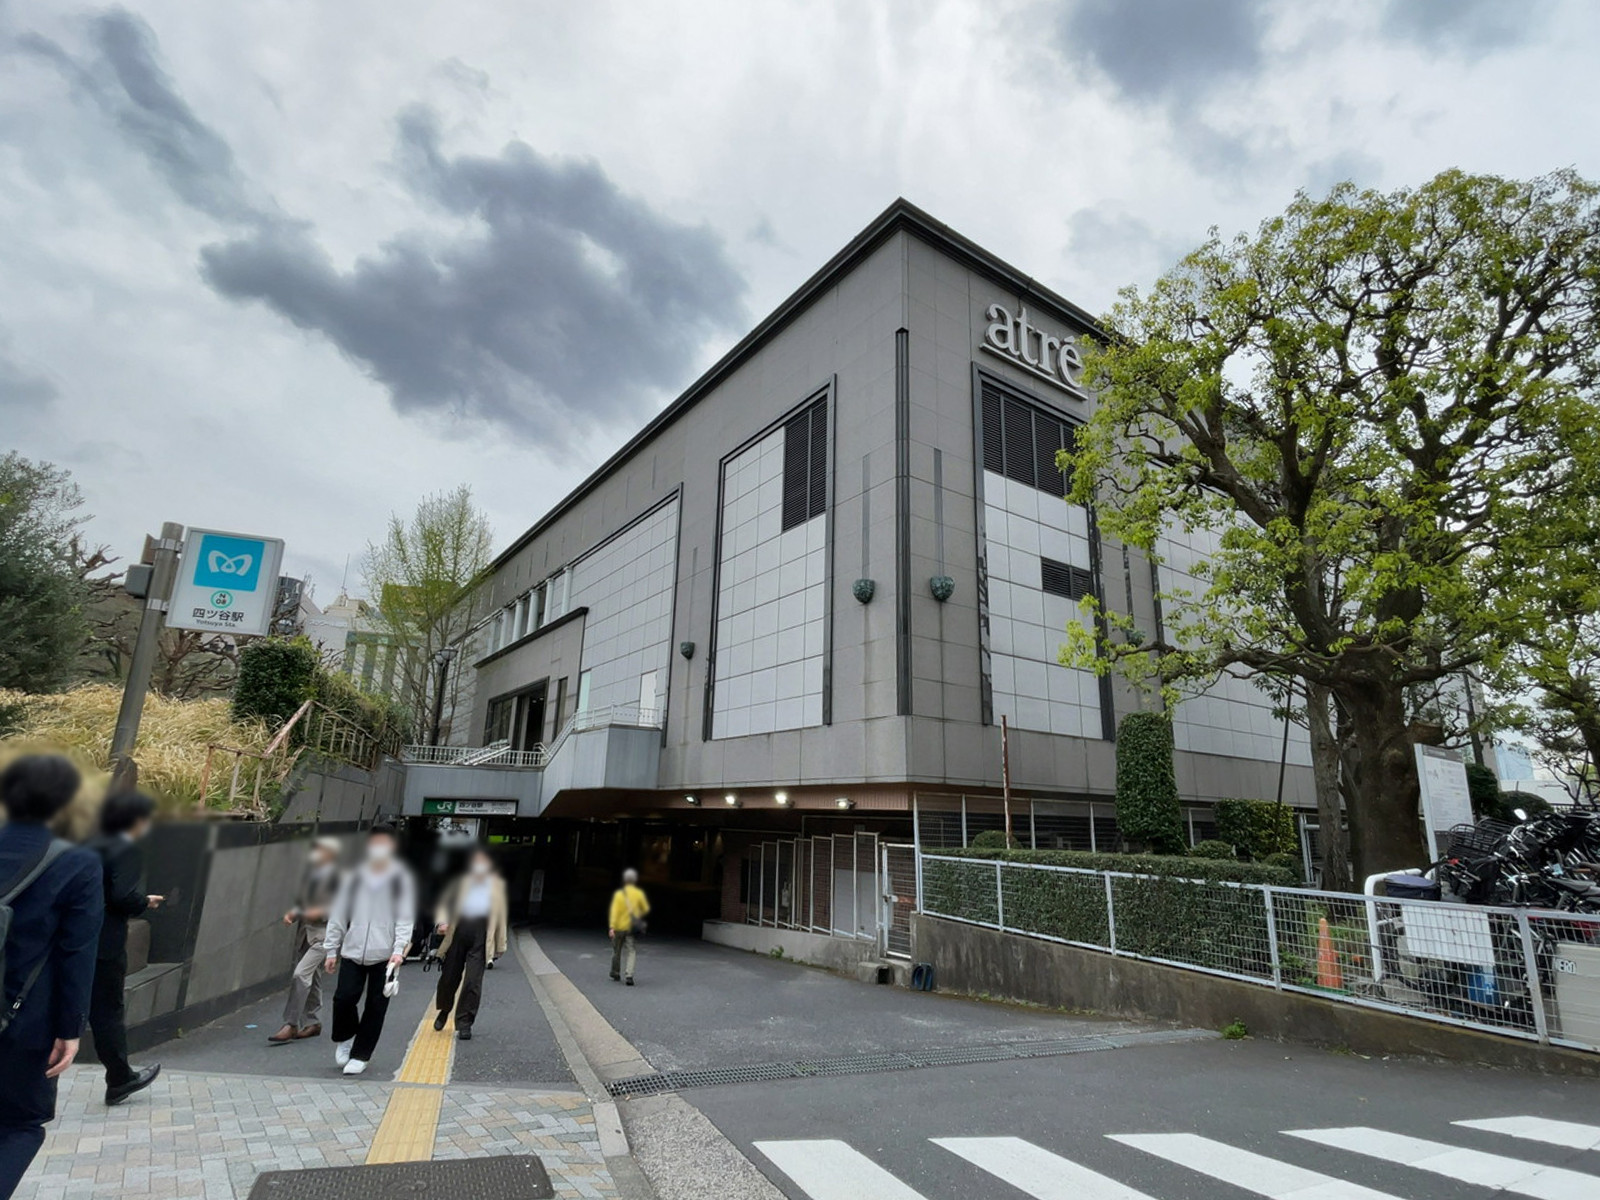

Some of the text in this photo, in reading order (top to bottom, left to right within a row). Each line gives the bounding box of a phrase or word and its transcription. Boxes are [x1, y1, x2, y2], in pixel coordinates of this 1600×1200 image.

[193, 608, 244, 622] 四ツ谷駅
[437, 802, 453, 810] JR
